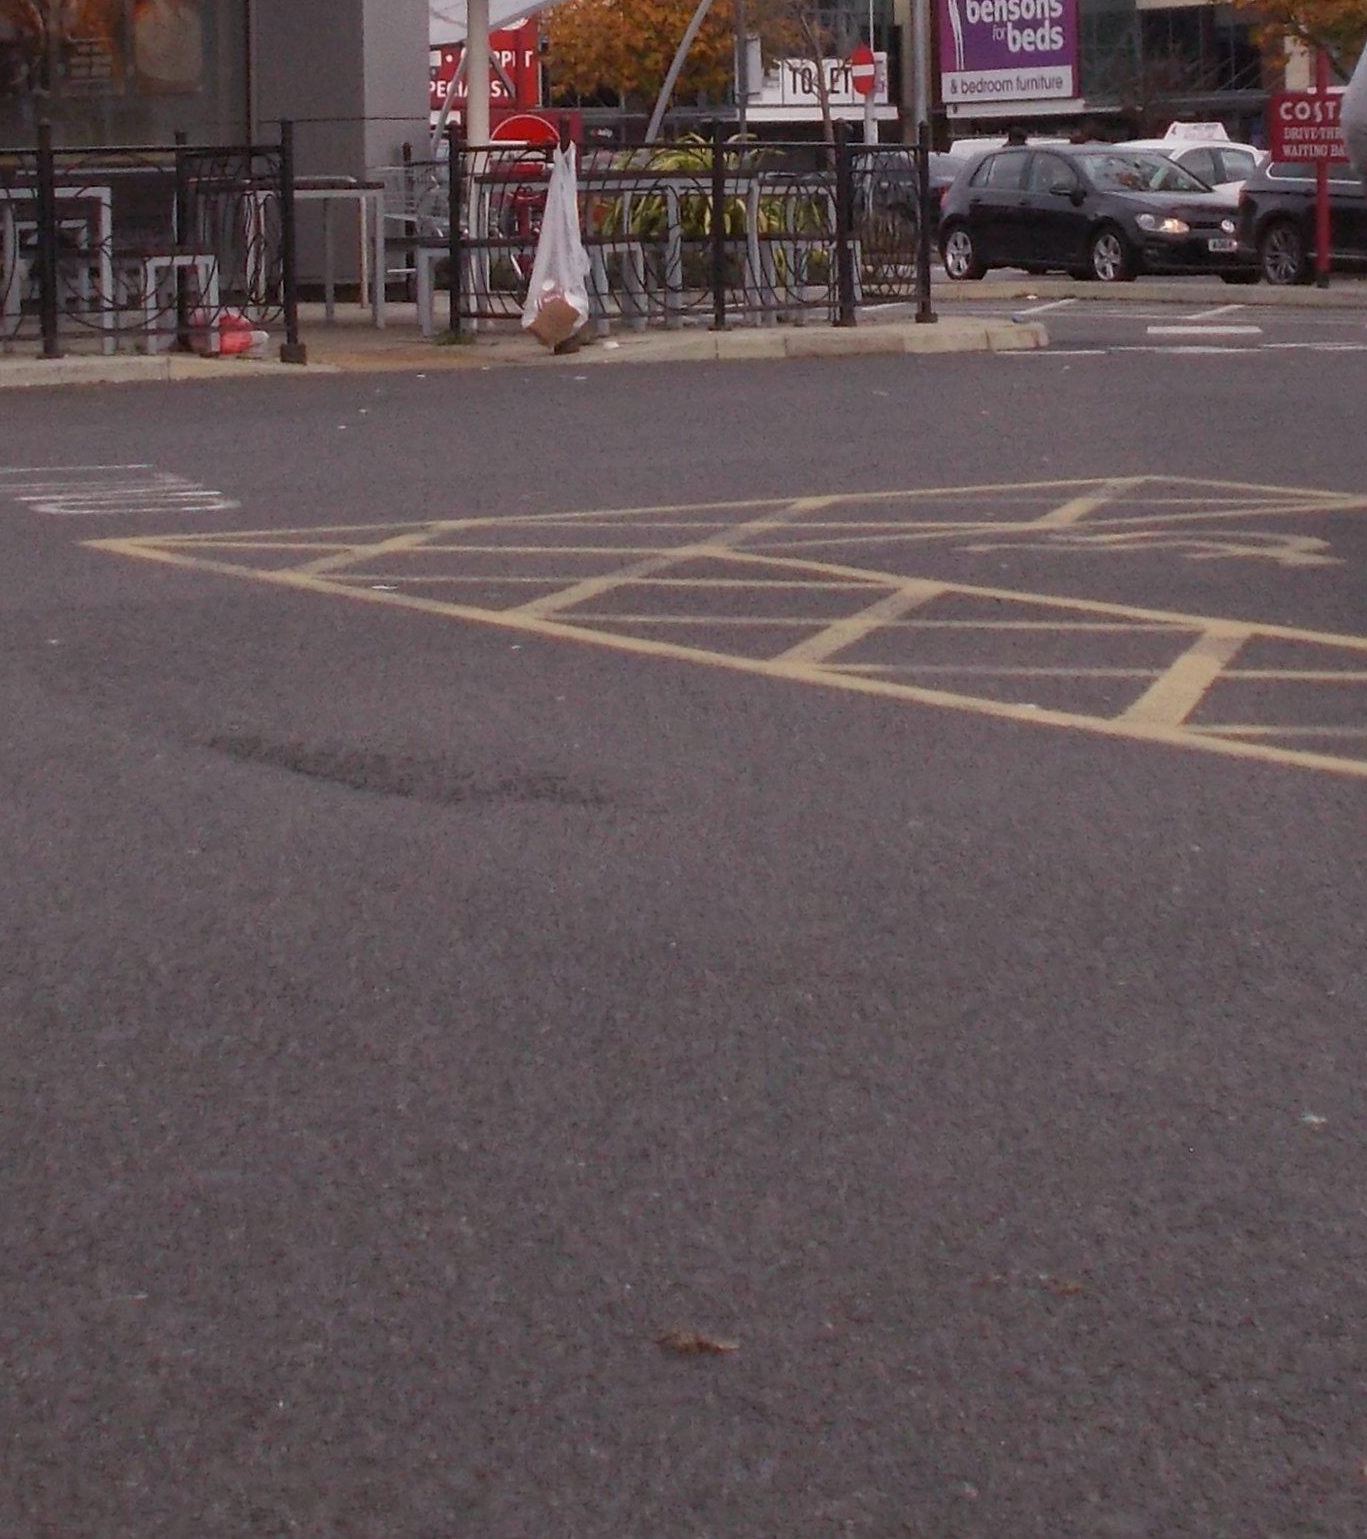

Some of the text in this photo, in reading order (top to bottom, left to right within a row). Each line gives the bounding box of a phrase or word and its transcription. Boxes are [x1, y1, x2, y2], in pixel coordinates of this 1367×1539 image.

[992, 19, 1064, 53] for beds
[823, 66, 853, 94] ET
[950, 75, 1064, 95] & bedroom furniture
[1279, 100, 1343, 123] COST
[1284, 126, 1344, 141] DRIVE-THR
[1282, 143, 1347, 158] WAITING BA
